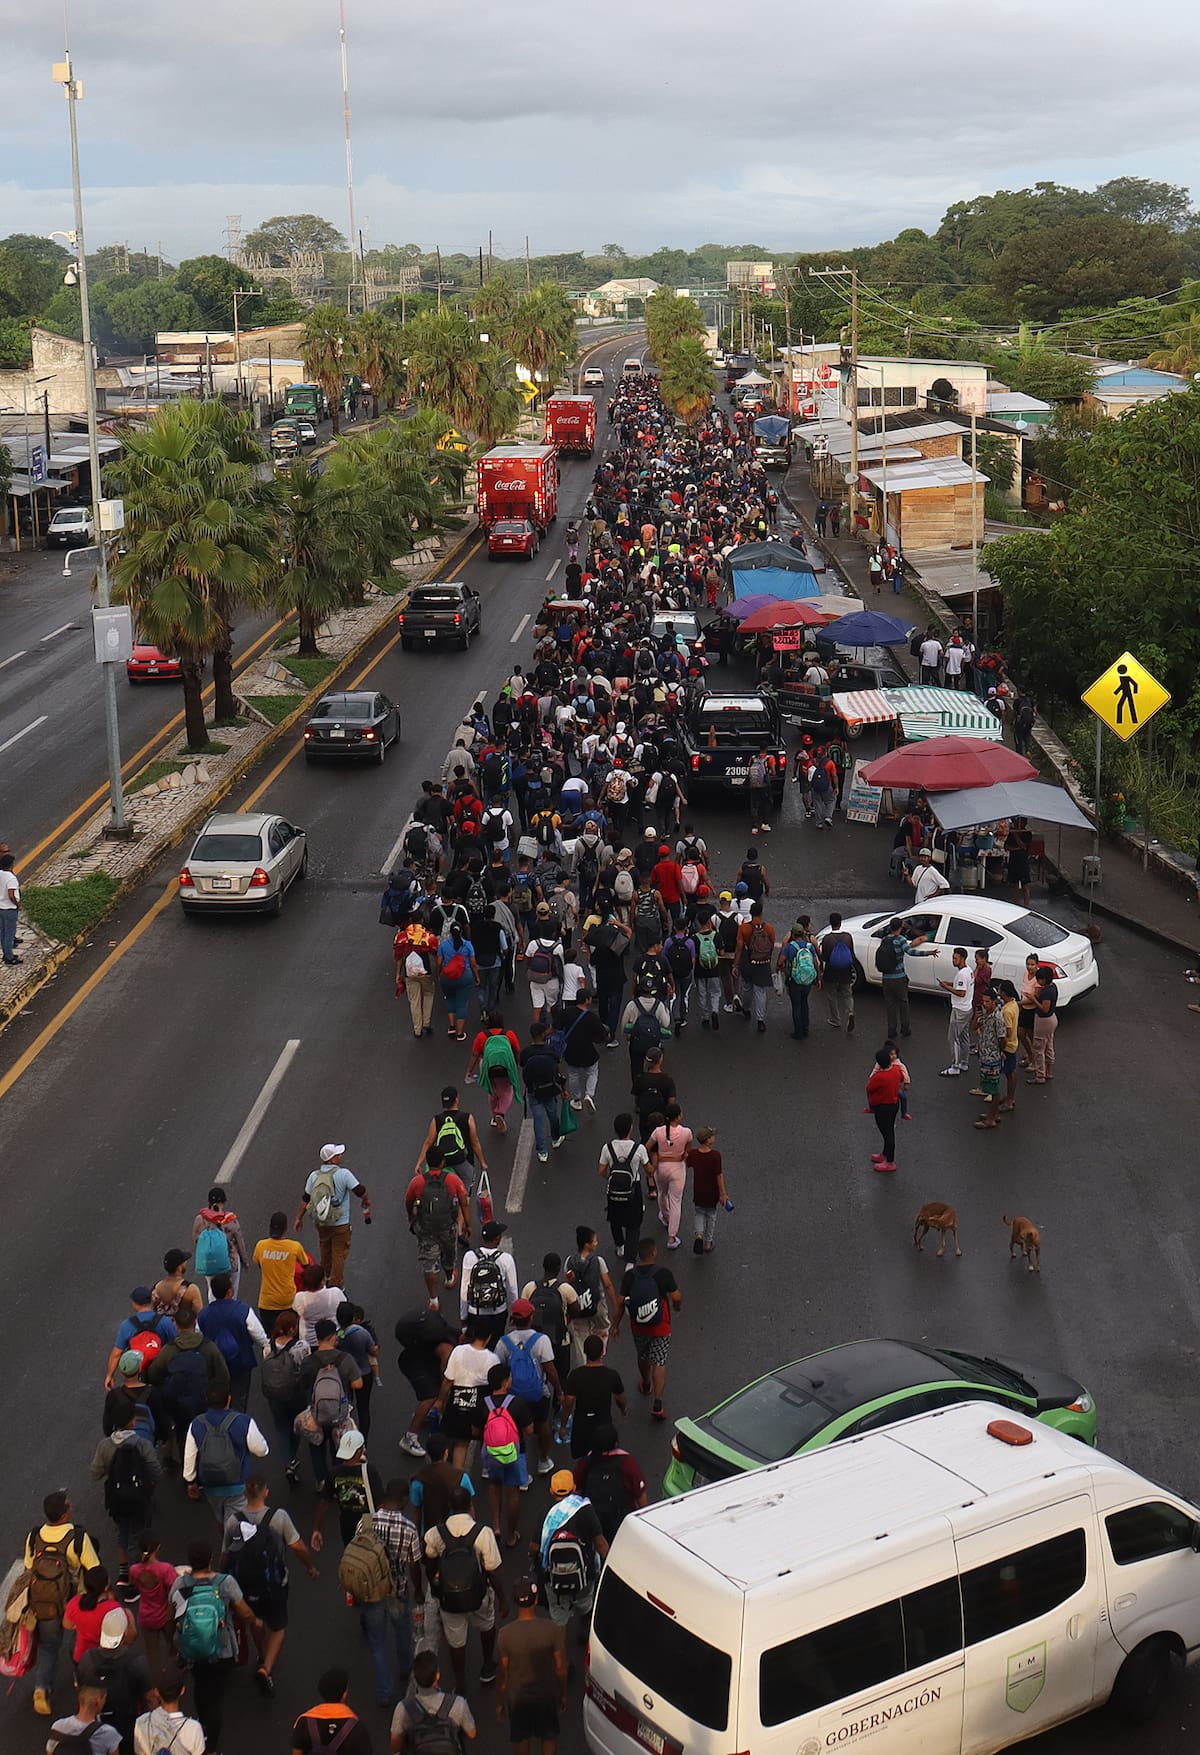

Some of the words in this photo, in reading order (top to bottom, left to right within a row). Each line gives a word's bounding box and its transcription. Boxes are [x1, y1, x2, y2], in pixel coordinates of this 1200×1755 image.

[263, 1249, 289, 1260] NAVY
[638, 1298, 658, 1318] NIKE
[825, 1687, 942, 1746] GOBERNACIÓN
